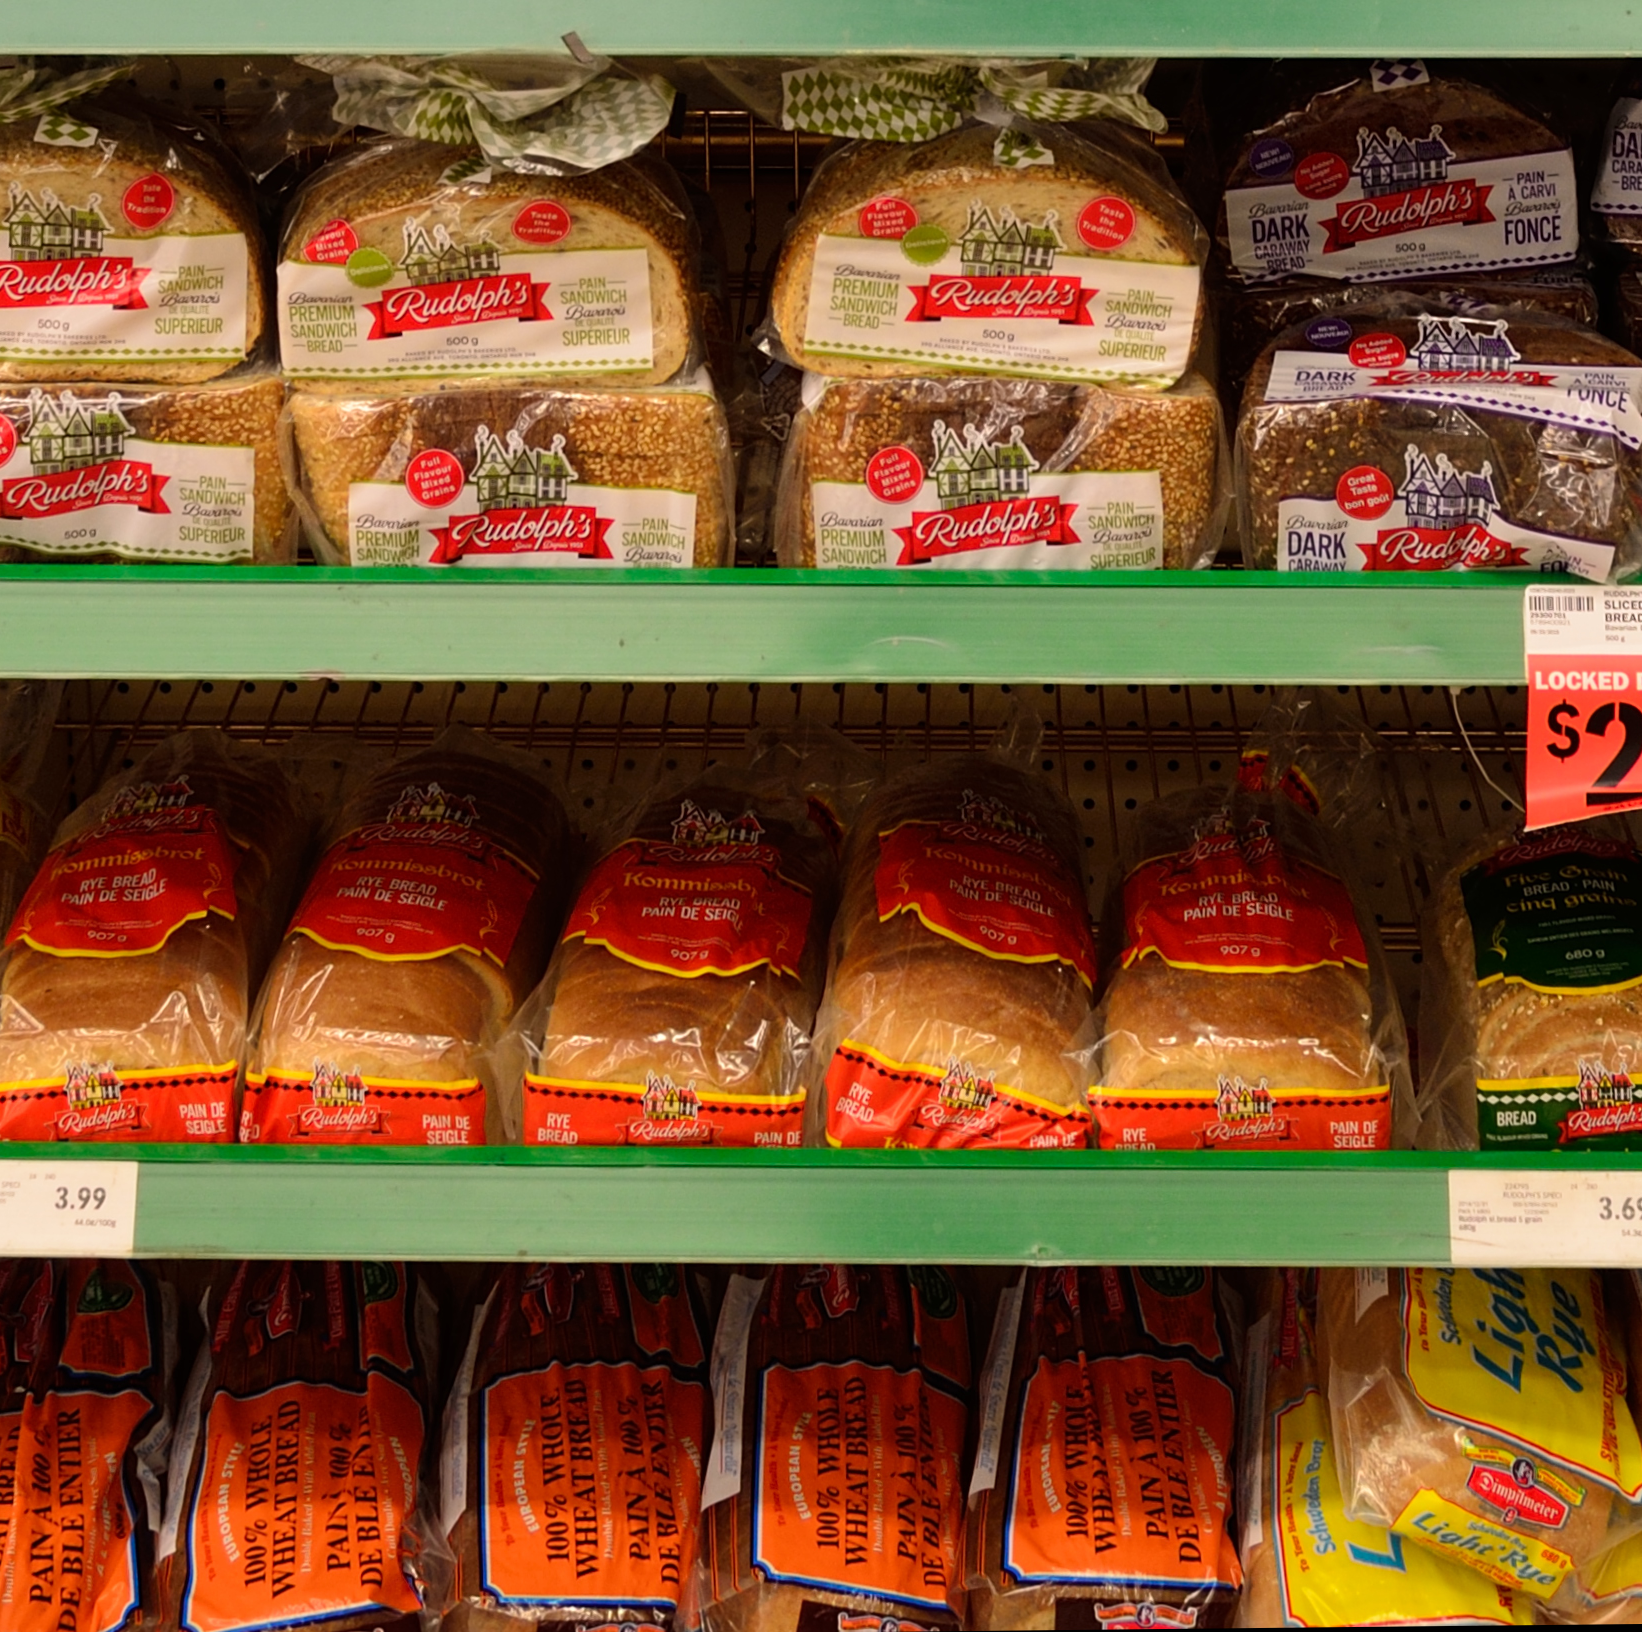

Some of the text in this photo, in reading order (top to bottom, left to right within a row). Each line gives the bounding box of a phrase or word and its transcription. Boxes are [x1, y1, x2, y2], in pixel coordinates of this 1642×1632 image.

[1252, 219, 1310, 246] DARK
[1504, 214, 1561, 245] FONCÉ
[387, 280, 528, 327] Rudolph's
[561, 290, 627, 305] SANDWICH
[930, 279, 1078, 313] Rudolph's
[289, 305, 355, 322] PREMIUM
[290, 321, 357, 337] SANDWICH
[446, 335, 479, 350] 500 g
[1345, 471, 1377, 489] Great
[1343, 495, 1362, 509] bon
[1347, 485, 1378, 501] Taste
[1288, 530, 1347, 560] DARK
[1535, 672, 1629, 690] LOCKED
[1523, 877, 1615, 897] BREAD PAIN
[1220, 943, 1245, 958] 907
[179, 1101, 226, 1119] PAIN DE
[1496, 1110, 1537, 1128] BREAD
[185, 1116, 227, 1135] SEIGLE
[55, 1186, 107, 1211] 3.99
[571, 1469, 599, 1580] WHEAT
